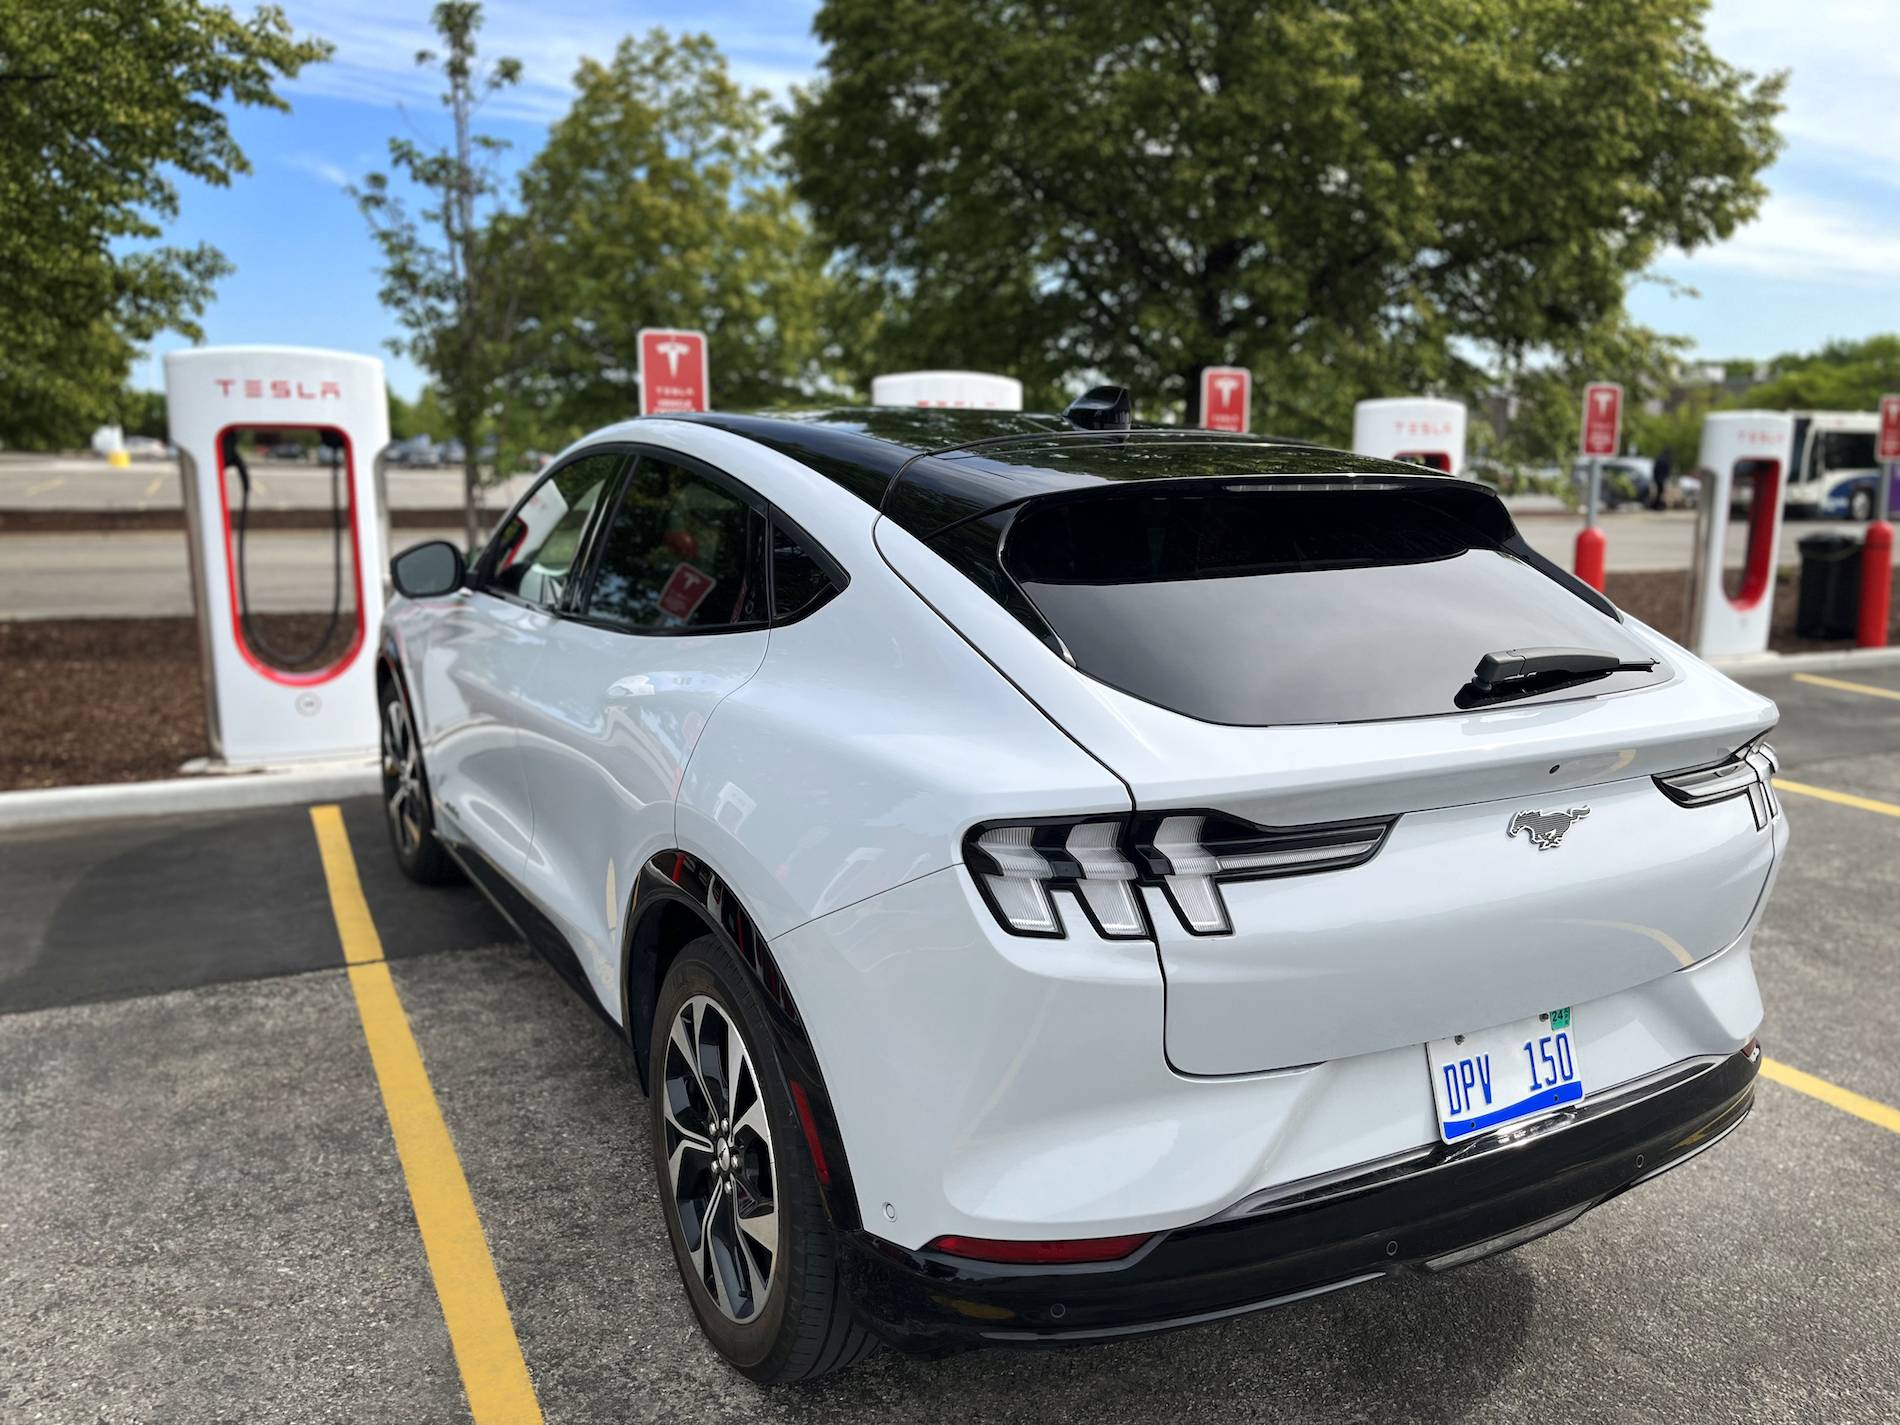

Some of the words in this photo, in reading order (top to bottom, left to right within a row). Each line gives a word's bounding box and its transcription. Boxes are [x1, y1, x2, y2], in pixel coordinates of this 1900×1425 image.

[214, 379, 341, 399] TESLA
[1551, 1009, 1564, 1022] 24
[1443, 1053, 1493, 1116] DPV
[1523, 1032, 1574, 1092] 150
